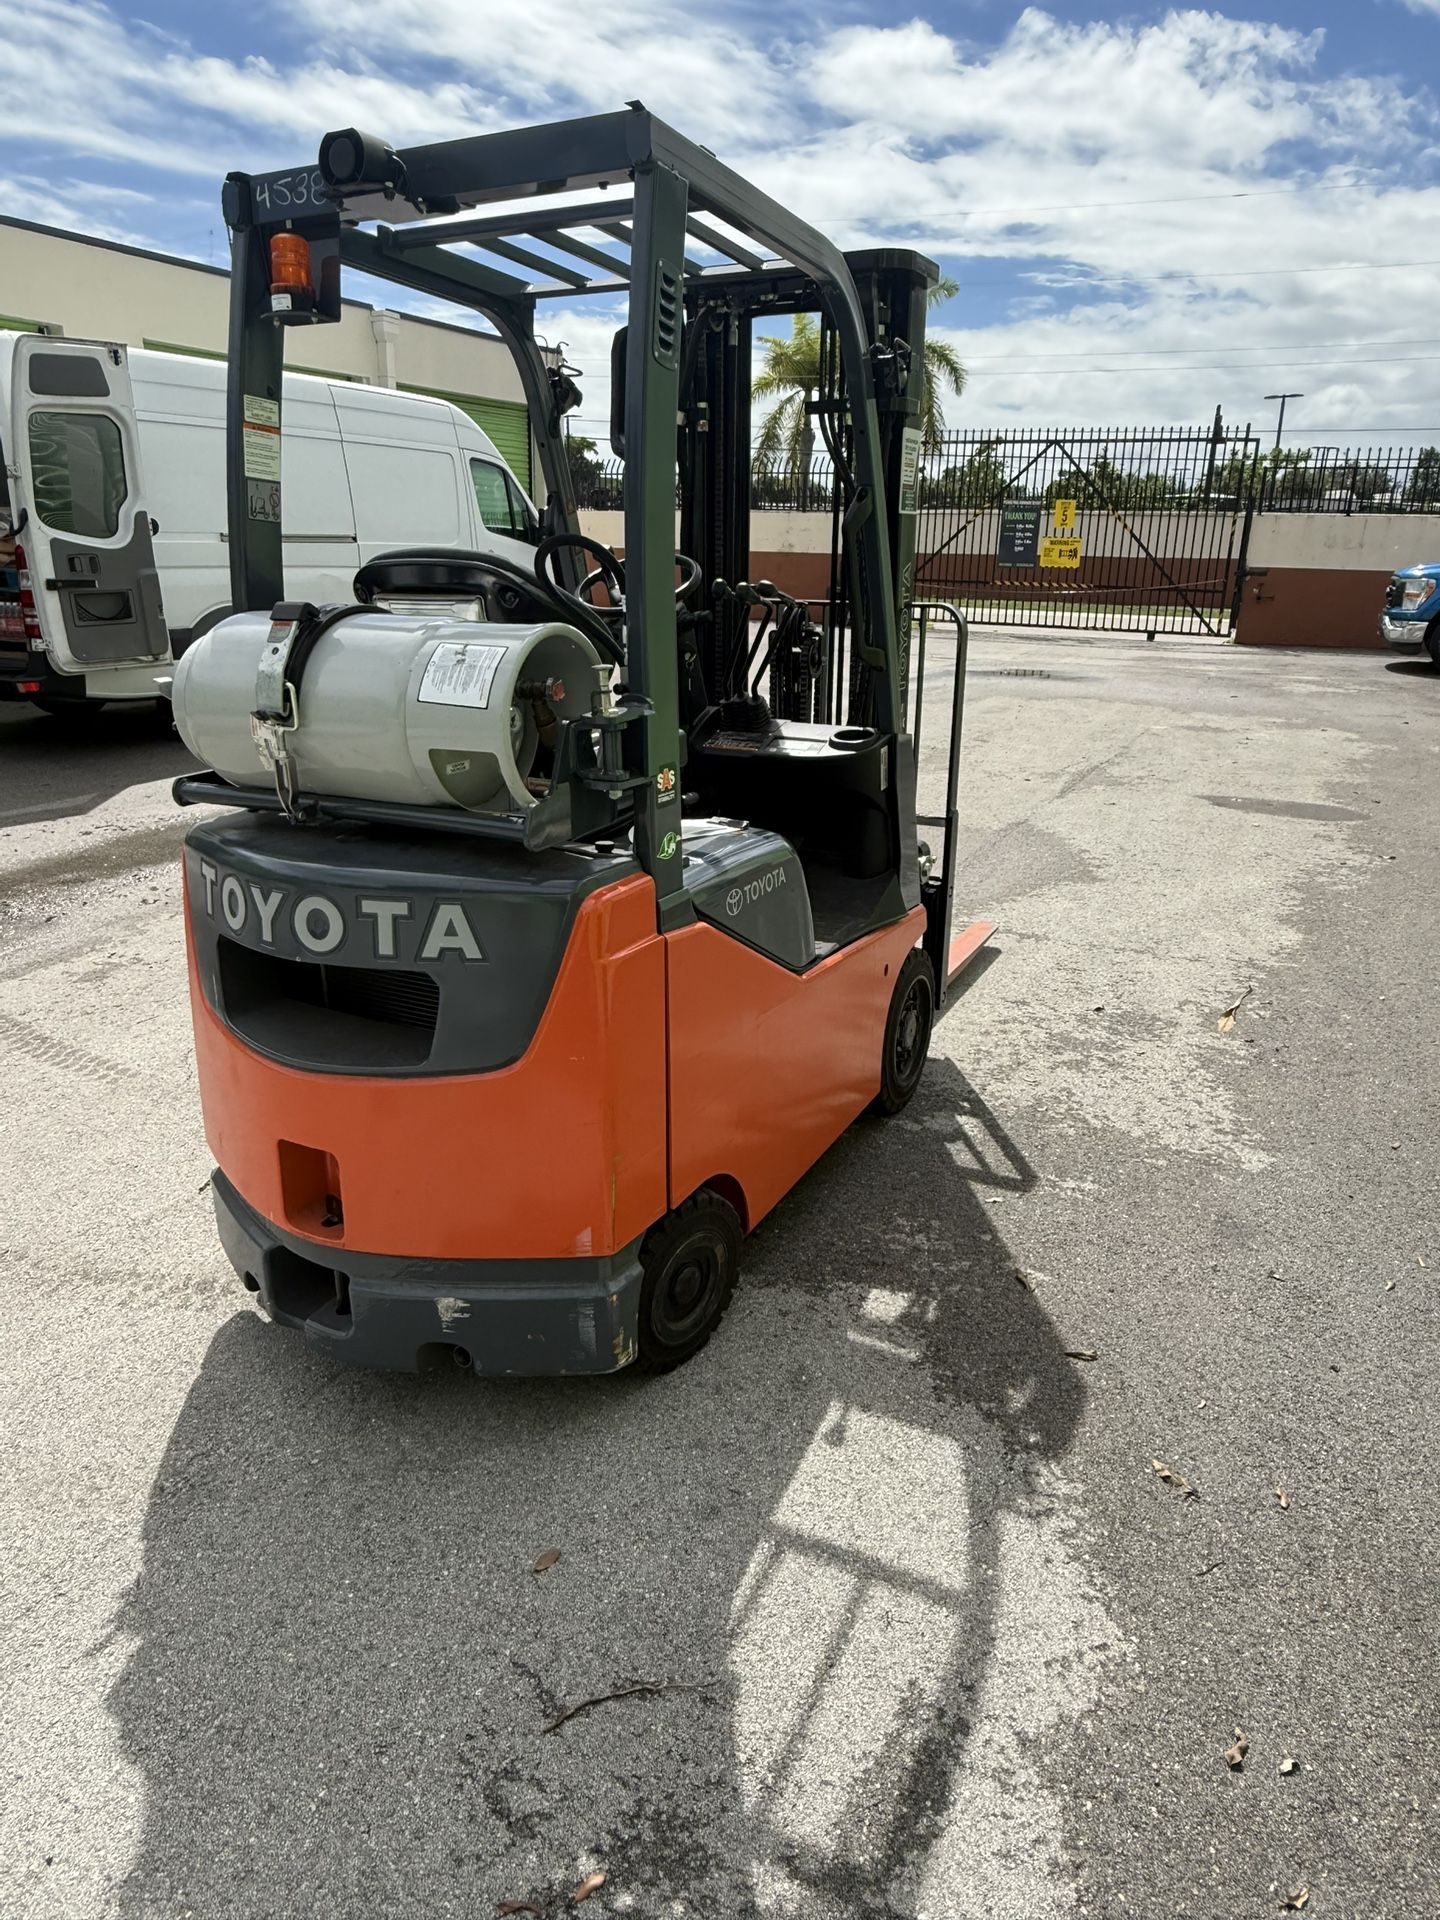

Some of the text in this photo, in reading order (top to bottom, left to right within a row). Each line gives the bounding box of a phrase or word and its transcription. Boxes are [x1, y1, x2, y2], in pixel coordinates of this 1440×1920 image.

[1062, 510, 1068, 522] 5
[899, 562, 911, 691] TOYOTA
[657, 768, 675, 791] SAS
[744, 867, 786, 903] TOYOTA
[201, 861, 483, 960] TOYOTA
